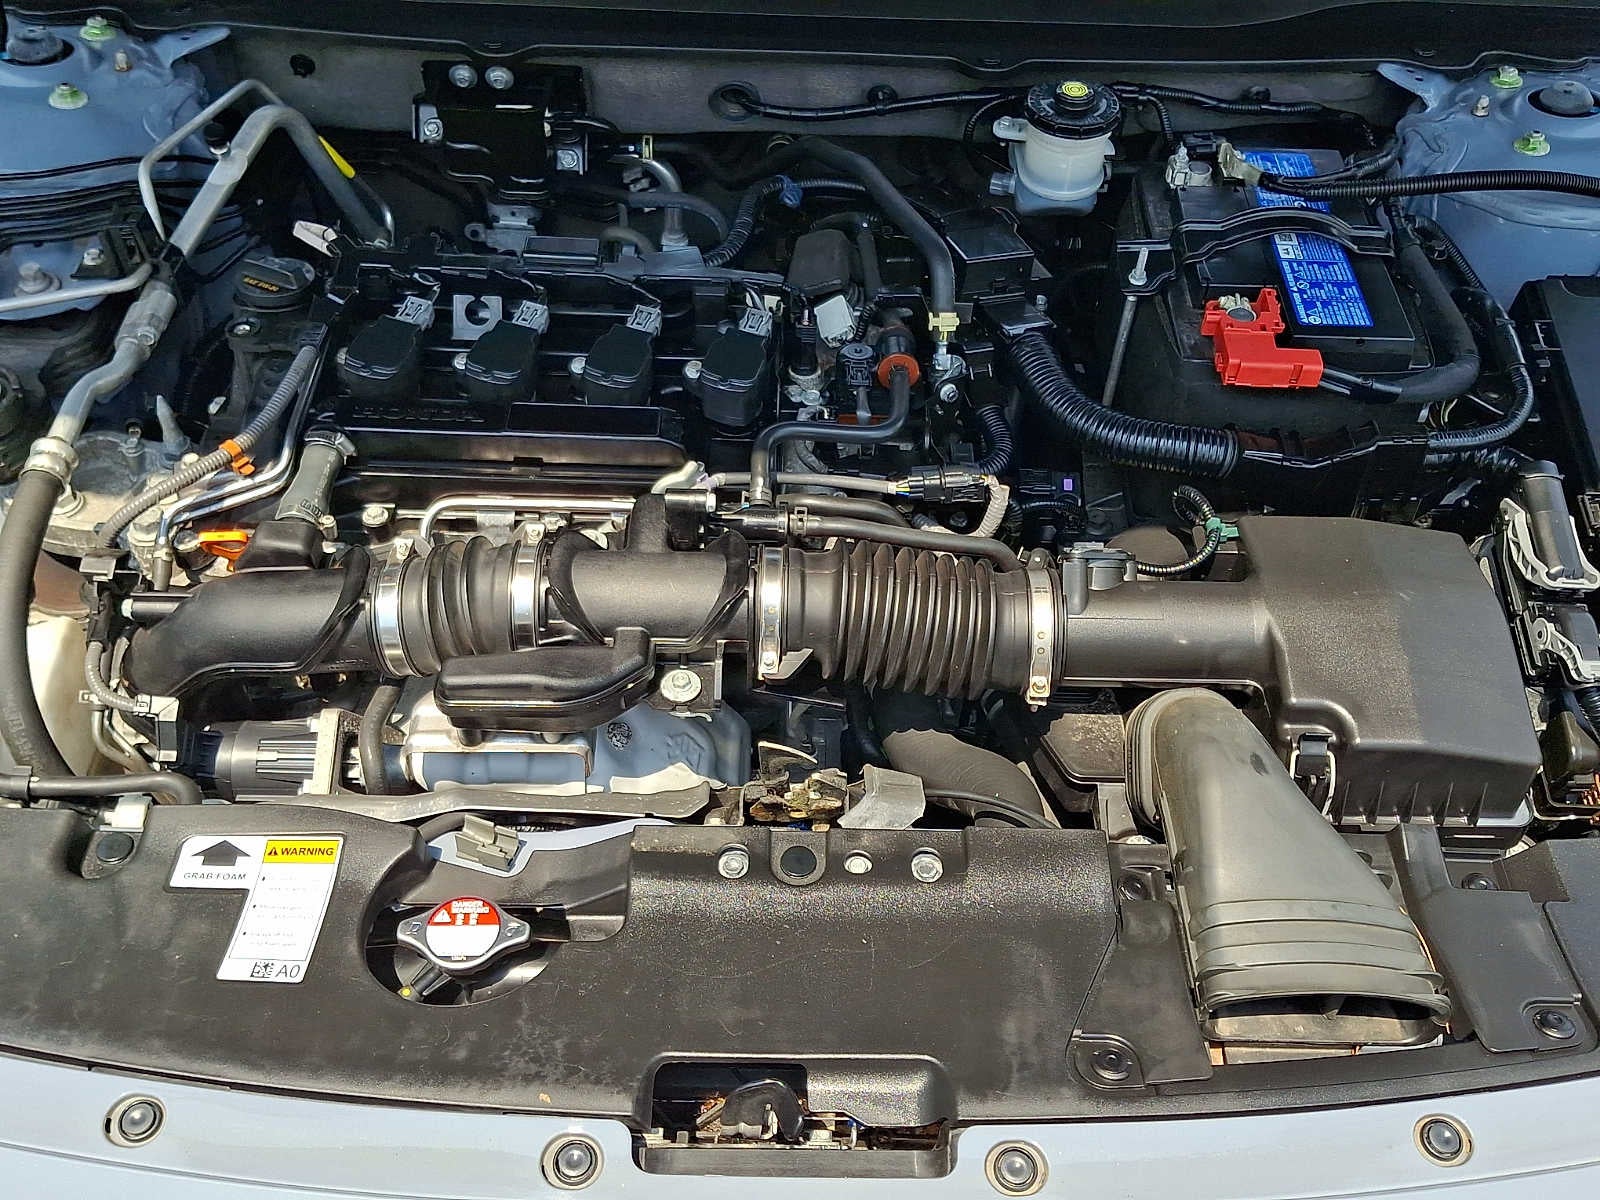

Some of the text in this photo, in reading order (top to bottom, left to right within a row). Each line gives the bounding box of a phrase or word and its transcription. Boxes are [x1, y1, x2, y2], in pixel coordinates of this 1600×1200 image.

[281, 847, 335, 856] WARNING
[183, 873, 247, 881] GRAB FOAM
